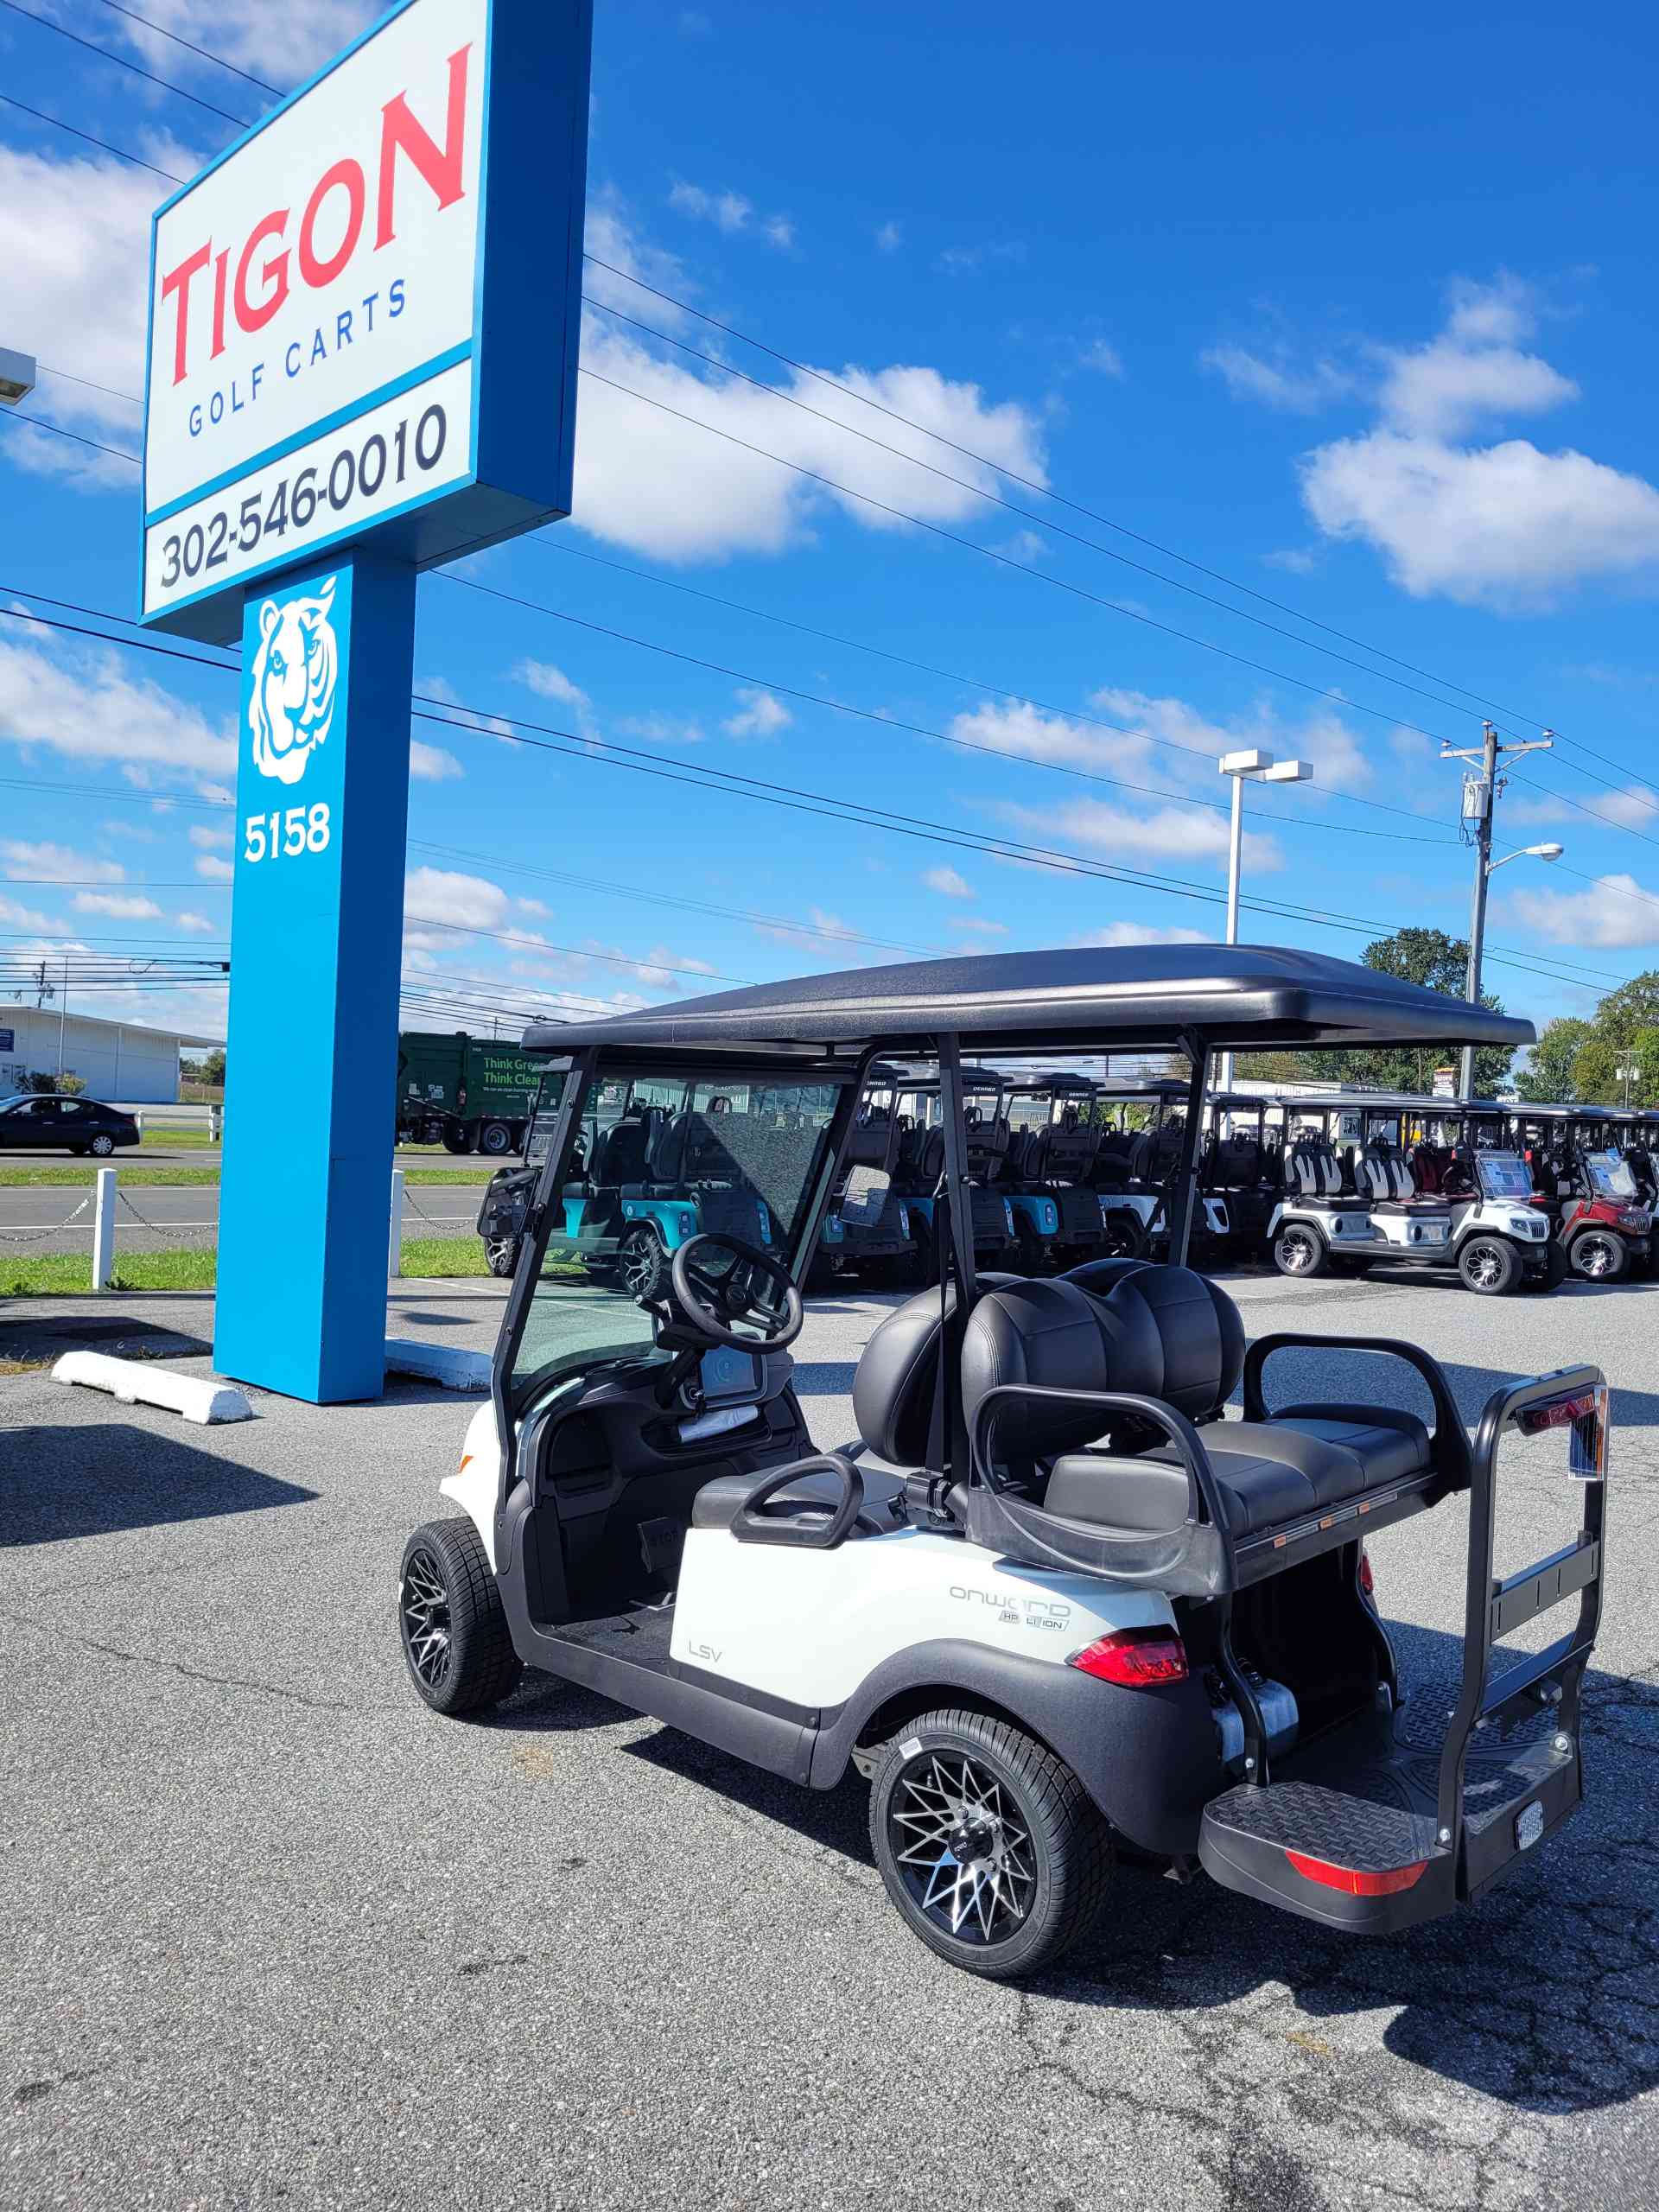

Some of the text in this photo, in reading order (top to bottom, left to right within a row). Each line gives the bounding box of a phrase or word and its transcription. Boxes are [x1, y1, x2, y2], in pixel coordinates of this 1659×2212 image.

[162, 41, 473, 387] TIGON
[188, 278, 406, 437] GOLF CARTS
[160, 403, 447, 588] 302-546-0010
[244, 802, 330, 863] 5158
[483, 1057, 513, 1070] Think
[483, 1071, 512, 1084] Think
[689, 1639, 722, 1662] LSV
